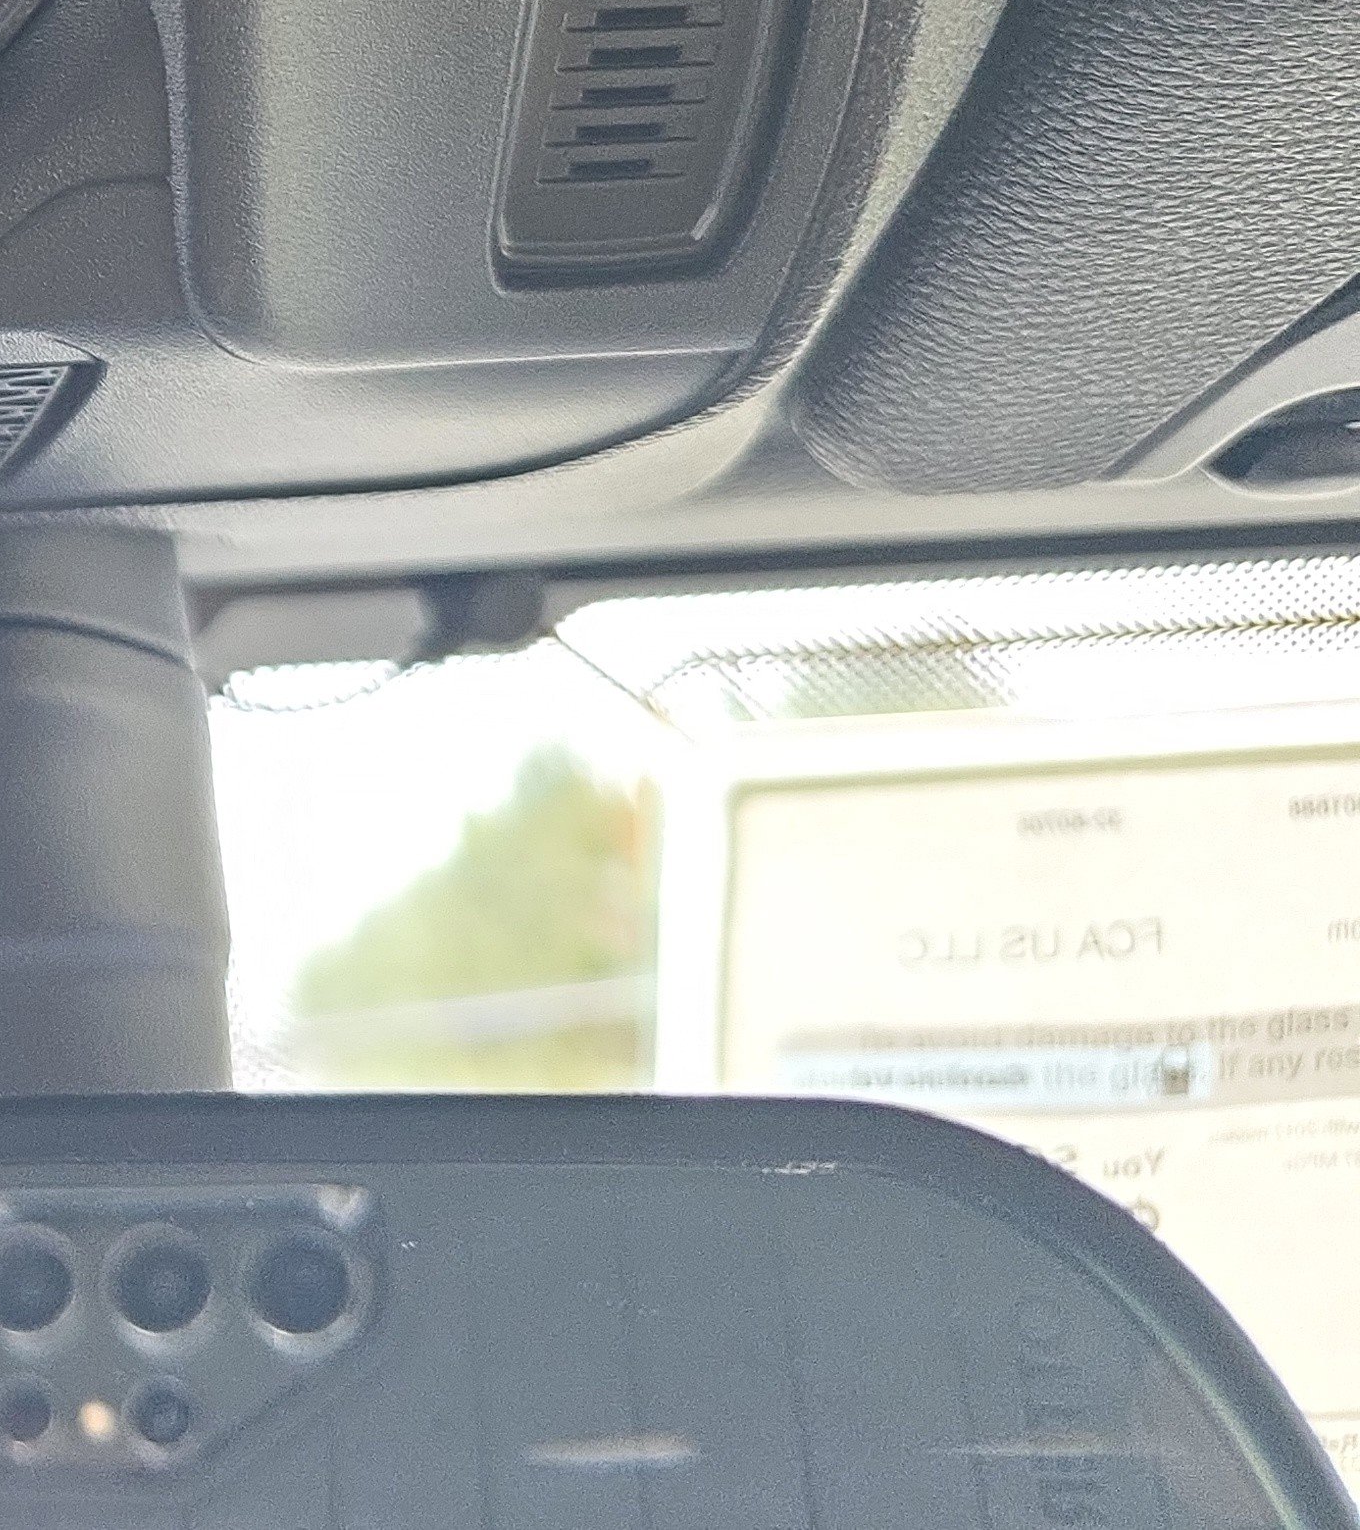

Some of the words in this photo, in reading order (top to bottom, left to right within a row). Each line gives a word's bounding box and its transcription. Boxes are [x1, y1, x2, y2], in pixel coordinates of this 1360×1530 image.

[1207, 1015, 1258, 1042] the
[1266, 1008, 1351, 1044] glass
[1248, 1051, 1304, 1083] any
